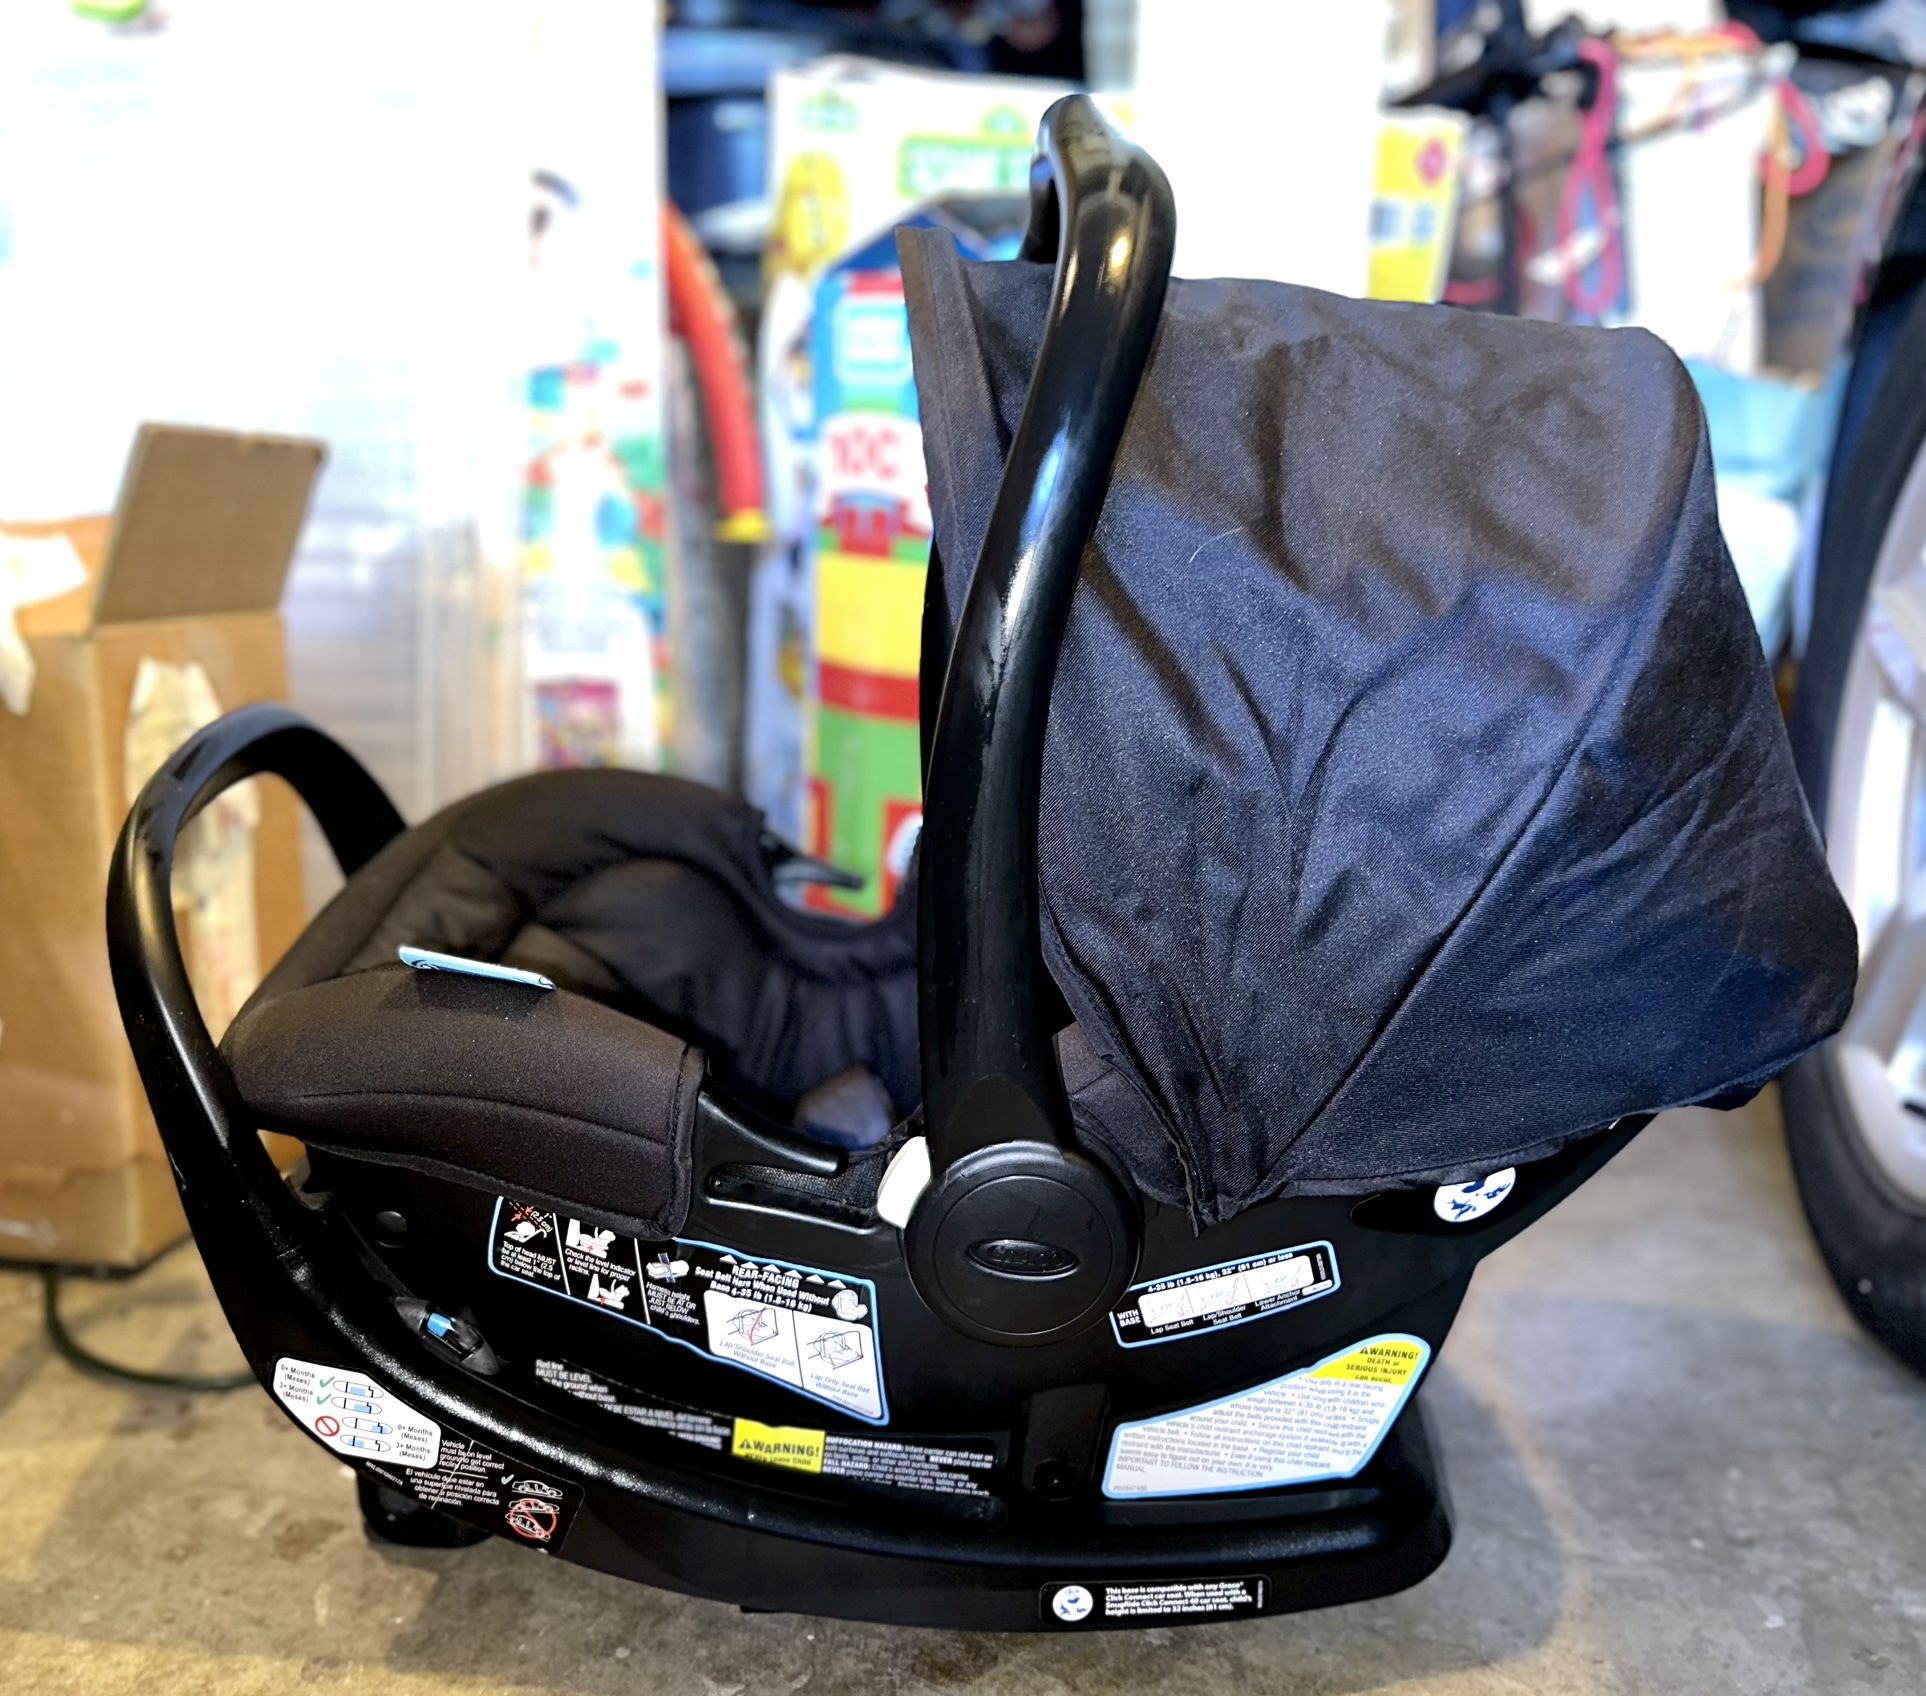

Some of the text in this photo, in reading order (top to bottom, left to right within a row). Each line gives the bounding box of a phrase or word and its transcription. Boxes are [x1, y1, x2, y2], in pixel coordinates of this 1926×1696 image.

[732, 1265, 799, 1289] REAR-FACING
[695, 1266, 829, 1305] Seat Belt Here When Used Without
[1254, 1289, 1300, 1307] Lower Anchor
[1260, 1296, 1298, 1311] Attachment
[1117, 1309, 1139, 1320] WITH
[1120, 1317, 1141, 1327] BASE
[1165, 1322, 1180, 1330] Seat
[1370, 1347, 1419, 1360] WARNING!
[1367, 1357, 1390, 1365] DEATH
[1346, 1364, 1407, 1376] SERIOUS INJURY
[442, 1440, 465, 1449] Vehicle
[826, 1436, 873, 1448] SUFFOCATION
[753, 1440, 819, 1457] WARNING!
